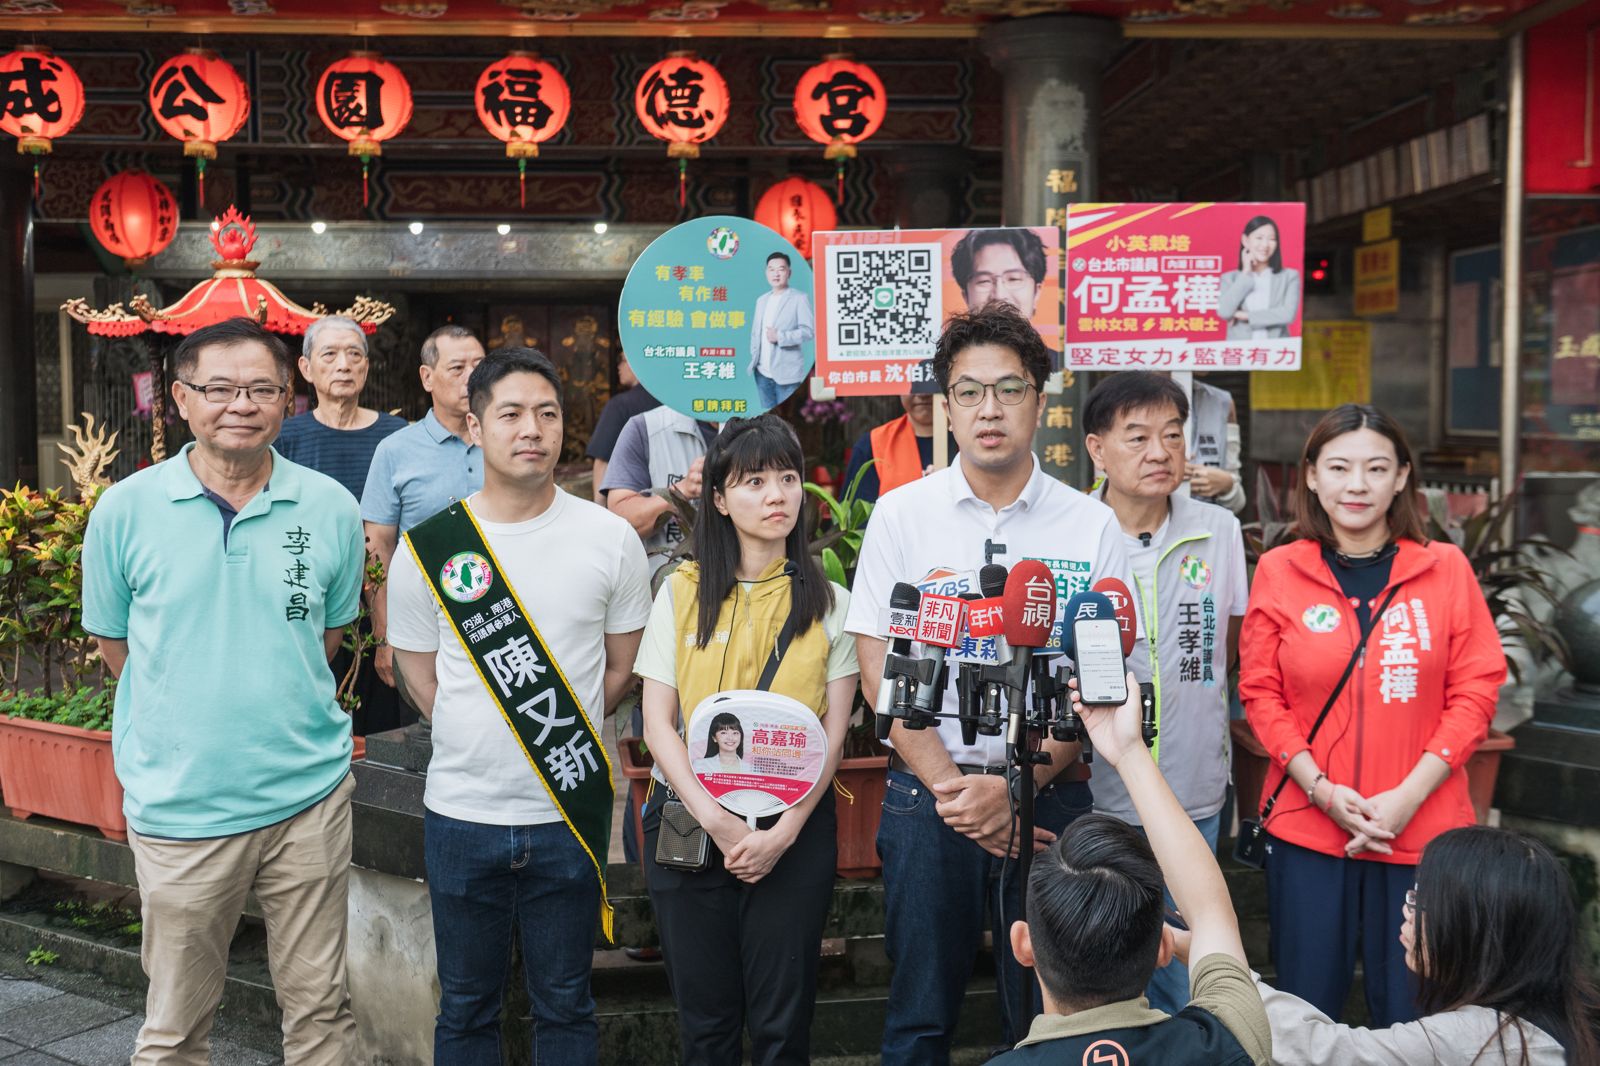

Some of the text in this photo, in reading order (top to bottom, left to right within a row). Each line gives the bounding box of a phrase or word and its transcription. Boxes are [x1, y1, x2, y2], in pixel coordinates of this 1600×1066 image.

[0, 57, 63, 123] 成
[153, 65, 226, 121] 公
[482, 69, 554, 130] 福
[642, 66, 714, 129] 德
[812, 71, 876, 137] 宮
[1106, 235, 1191, 252] 小英栽培
[655, 265, 705, 281] 有孝率
[1088, 257, 1158, 272] 台北市議員
[679, 285, 728, 302] 有作維
[1073, 274, 1221, 314] 何孟樺
[628, 309, 746, 329] 有經驗 會做事
[644, 346, 696, 357] 台北市議員
[1071, 347, 1297, 367] 堅定女力 監督有力
[683, 362, 736, 379] 王孝維
[828, 370, 882, 384] 你的市長
[282, 526, 312, 622] 李建昌
[925, 601, 955, 621] 非凡
[1021, 575, 1053, 629] 台視
[970, 606, 1003, 628] 年代
[922, 620, 953, 641] 新聞
[1203, 597, 1216, 682] 台北市議員
[955, 637, 999, 660] 東森
[1178, 603, 1201, 682] 王孝維
[1379, 602, 1419, 704] 何孟樺
[483, 633, 600, 793] 陳又新
[752, 729, 807, 748] 高嘉瑜
